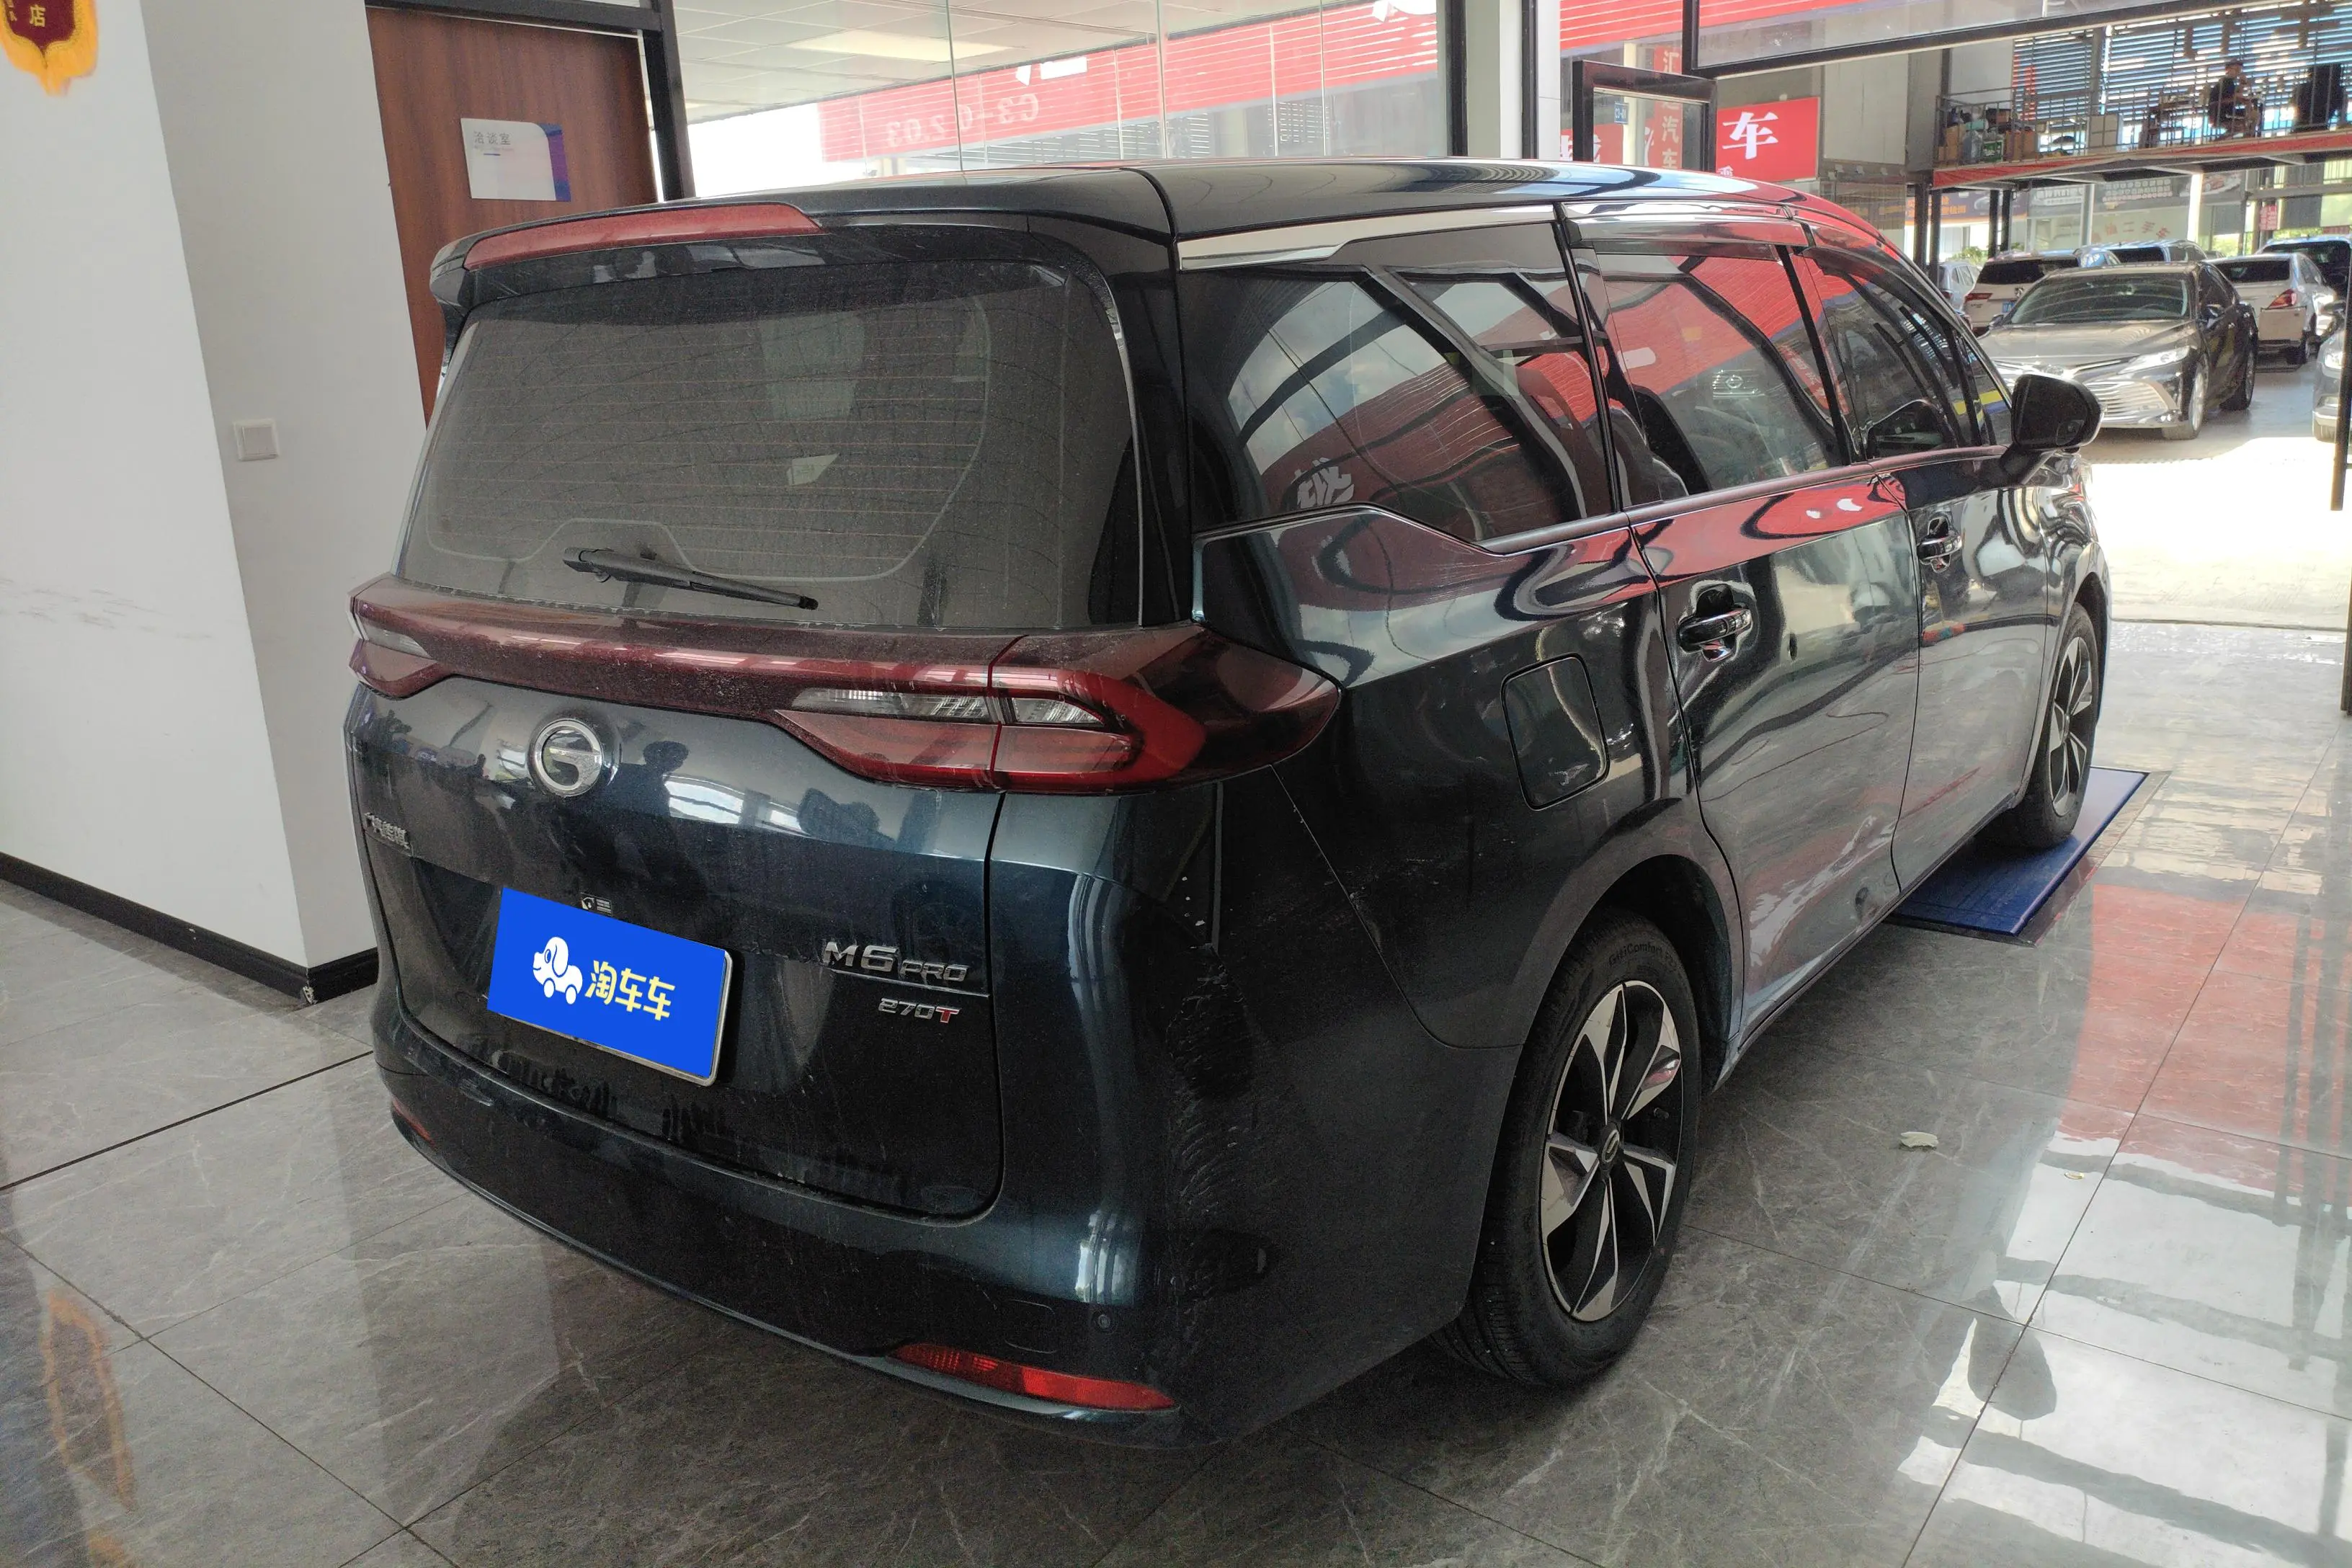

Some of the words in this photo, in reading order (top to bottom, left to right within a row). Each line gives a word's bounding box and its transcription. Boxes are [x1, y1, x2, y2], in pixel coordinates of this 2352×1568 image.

[30, 4, 46, 27] 店
[473, 130, 511, 145] 洽谈室
[1722, 112, 1778, 159] 车
[824, 941, 899, 972] M6
[901, 959, 969, 982] PRO
[878, 997, 960, 1024] 270T
